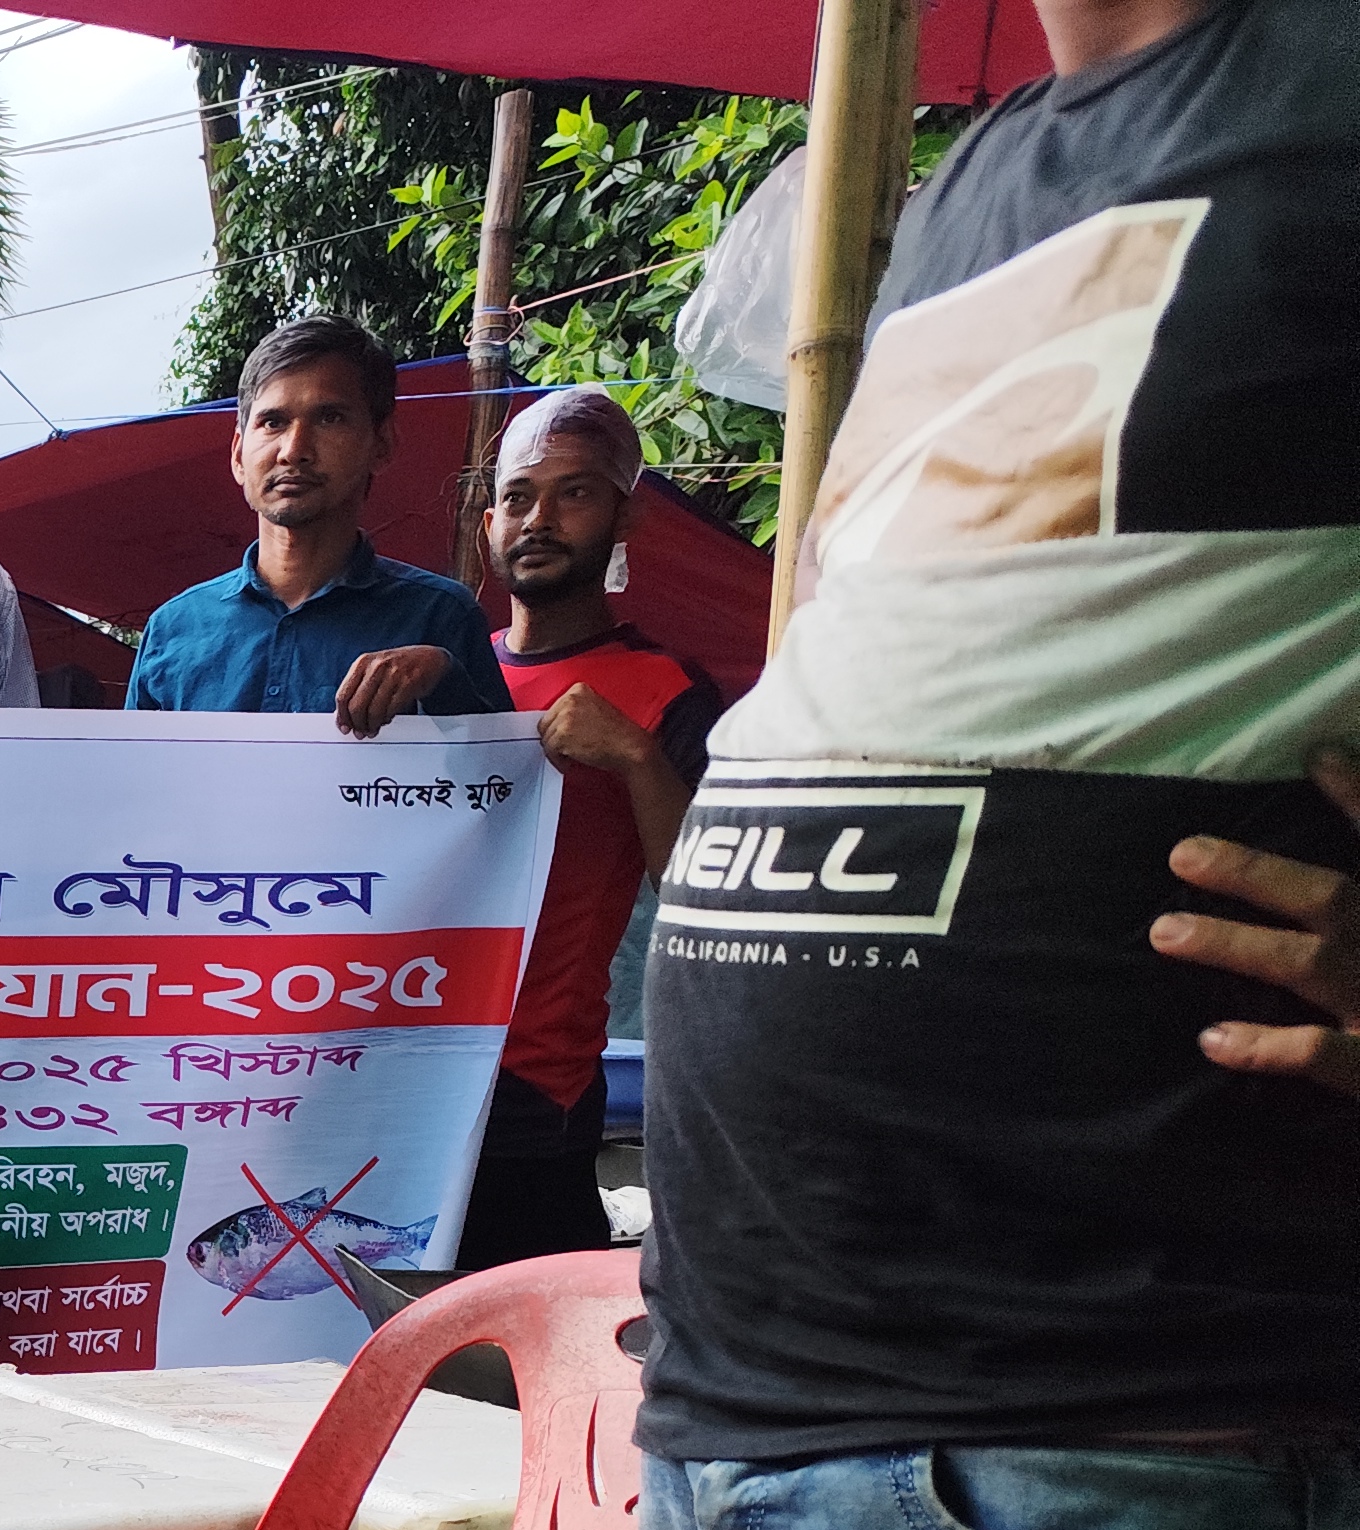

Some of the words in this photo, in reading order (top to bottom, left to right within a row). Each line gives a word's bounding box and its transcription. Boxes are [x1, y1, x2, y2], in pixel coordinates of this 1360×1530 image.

[338, 777, 457, 809] আমিষেই
[464, 774, 514, 813] মুক্তি
[54, 854, 386, 928] মৌসুমে
[667, 935, 787, 966] CALIFORNIA
[140, 1096, 300, 1130] বঙ্গাব্দ
[103, 1162, 174, 1193] মজুদ,
[59, 1206, 150, 1236] অপরাধ
[61, 1275, 150, 1310] সর্বোচ্চ
[9, 1332, 58, 1356] করা
[67, 1329, 122, 1354] যাবে
